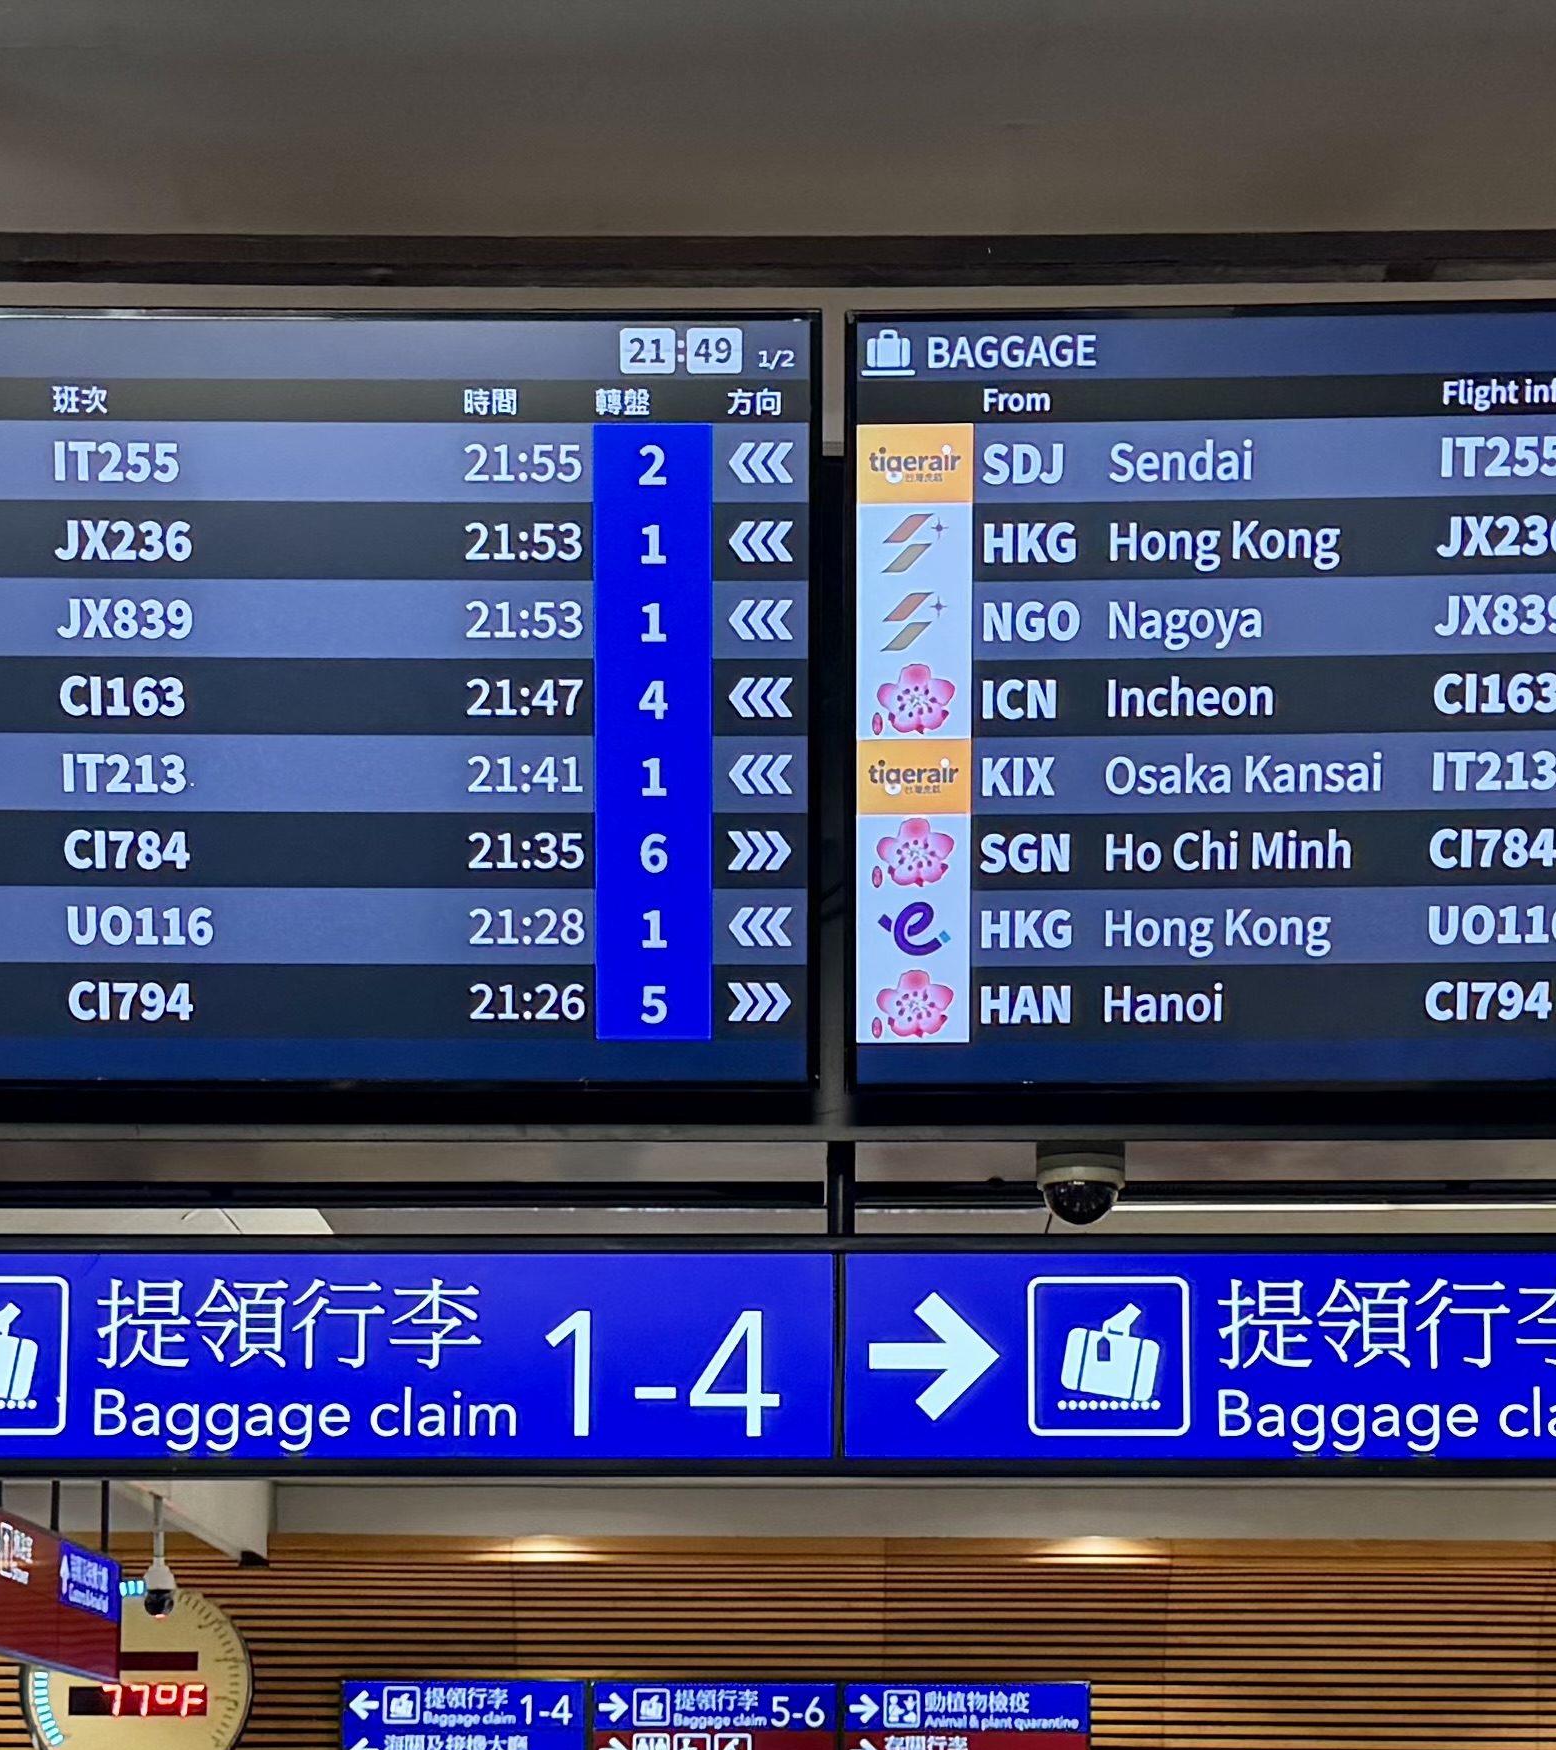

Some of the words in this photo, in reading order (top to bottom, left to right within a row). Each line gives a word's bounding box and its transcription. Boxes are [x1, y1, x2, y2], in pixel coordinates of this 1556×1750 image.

[758, 349, 795, 370] 1/2
[927, 334, 1097, 369] BAGGAGE
[51, 385, 108, 414] 班次
[463, 388, 517, 416] 時間
[594, 387, 650, 416] 轉盤
[727, 387, 782, 416] 方向
[983, 388, 1051, 413] From
[1442, 378, 1519, 412] Flight
[464, 443, 582, 483] 21:55
[869, 446, 961, 478] tigerair
[982, 443, 1064, 485] SDJ
[1109, 438, 1253, 483] Sendai
[464, 522, 583, 561] 21:53
[983, 521, 1077, 564] HKG
[1109, 521, 1221, 572] Hong
[1232, 520, 1341, 571] Kong
[465, 600, 583, 639] 21:53
[982, 600, 1081, 642] NGO
[1108, 600, 1262, 651] Nagoya
[466, 678, 584, 716] 21:47
[982, 678, 1057, 720] ICN
[1107, 675, 1274, 718] Incheon
[467, 755, 584, 793] 21:41
[981, 756, 1055, 797] KIX
[1105, 752, 1231, 795] Osaka
[1245, 751, 1383, 794] Kansai
[468, 831, 585, 870] 21:35
[979, 833, 1071, 874] SGN
[1105, 833, 1162, 872] Ho
[1173, 829, 1239, 871] Chi
[1251, 828, 1352, 870] Minh
[469, 908, 585, 946] 21:28
[980, 909, 1072, 949] HKG
[1105, 909, 1215, 958] Hong
[1225, 908, 1332, 957] Kong
[469, 983, 585, 1021] 21:26
[980, 985, 1072, 1025] HAN
[1104, 982, 1223, 1023] Hanoi
[1424, 980, 1553, 1021] CI794
[96, 1278, 482, 1370] 提領行李
[545, 1310, 781, 1438] 1-4
[93, 1388, 351, 1452] Baggage
[370, 1386, 517, 1437] claim
[1217, 1388, 1479, 1452] Baggage
[424, 1688, 508, 1710] 提領行李
[520, 1694, 573, 1725] 1-4
[674, 1689, 758, 1712] 提領行李
[771, 1696, 825, 1727] 5-6
[423, 1711, 479, 1727] Baggage
[482, 1711, 516, 1725] claim
[674, 1714, 732, 1729] Baggage
[735, 1714, 766, 1727] claim
[925, 1715, 967, 1729] Animal
[981, 1715, 1012, 1731] plant
[1014, 1715, 1079, 1731] quarantine
